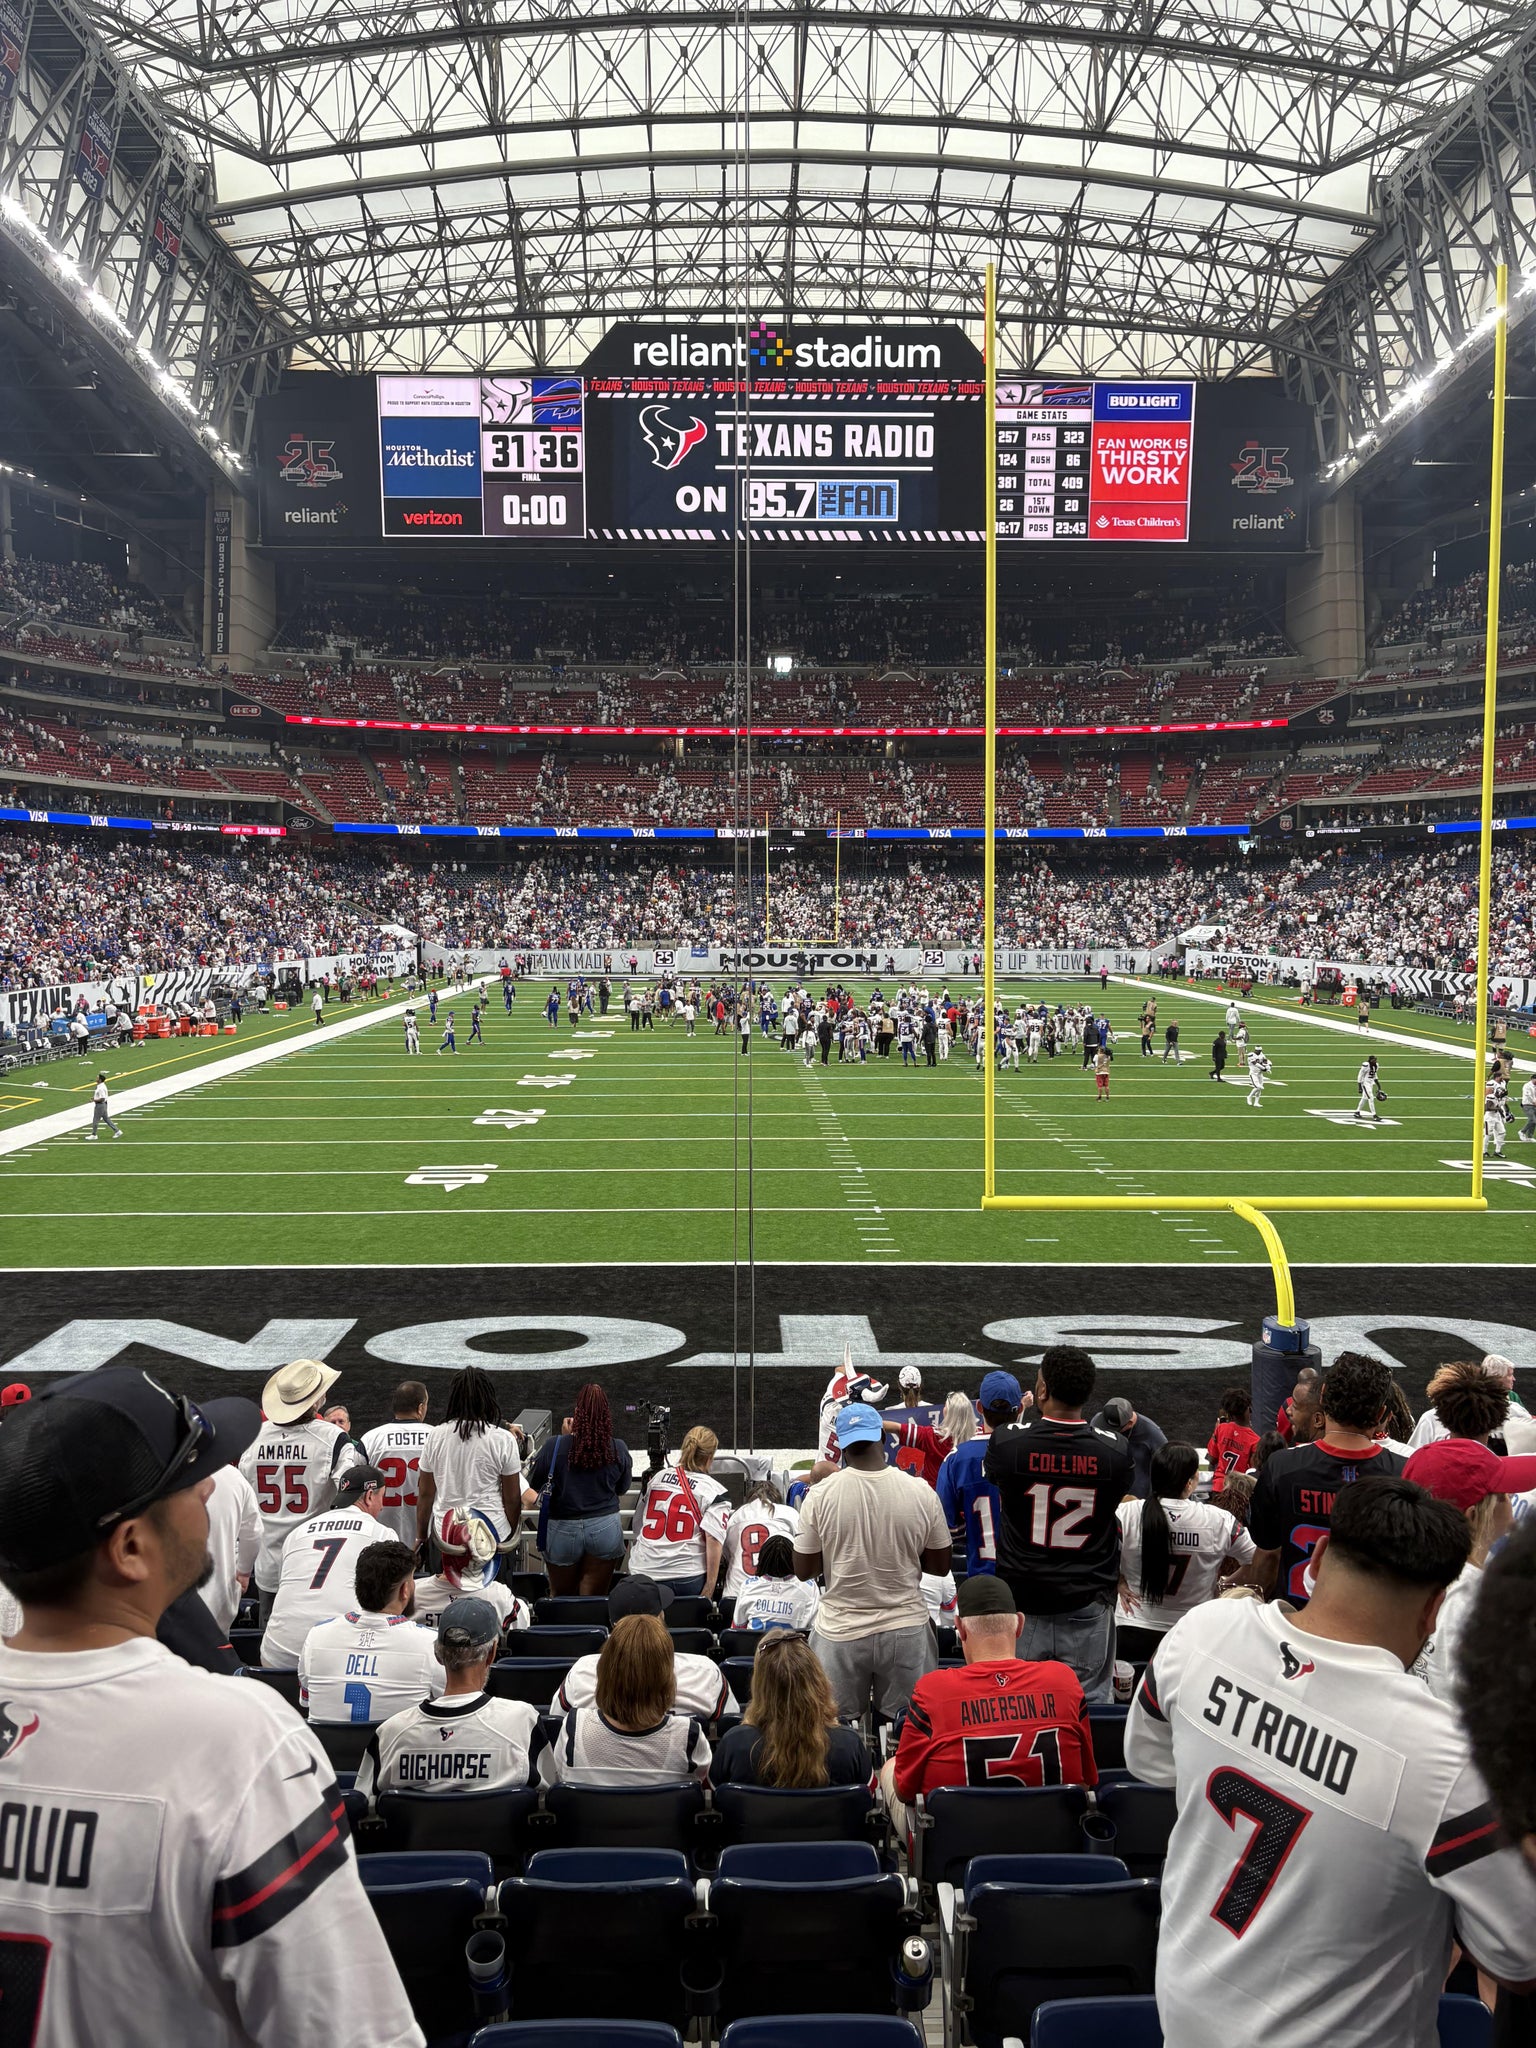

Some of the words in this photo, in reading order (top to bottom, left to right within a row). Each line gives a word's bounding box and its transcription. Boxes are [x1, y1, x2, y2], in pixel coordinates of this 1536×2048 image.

[81, 167, 98, 193] 2023
[155, 249, 170, 272] 2024
[633, 334, 747, 366] reliant
[795, 336, 941, 368] stadium
[590, 381, 623, 391] TEXANS
[631, 381, 670, 392] HOUSTON
[672, 381, 705, 392] TEXANS
[754, 382, 787, 392] TEXANS
[795, 382, 834, 393] HOUSTON
[836, 383, 869, 393] TEXANS
[877, 383, 915, 393] HOUSTON
[917, 383, 950, 393] TEXANS
[1110, 396, 1138, 407] BUD
[1138, 396, 1179, 407] LIGHT
[1017, 411, 1039, 419] GAME
[1042, 411, 1068, 420] STATS
[715, 423, 832, 457] TEXANS
[844, 424, 934, 458] RADIO
[998, 431, 1019, 444] 257
[1031, 433, 1051, 441] PASS
[1063, 431, 1085, 444] 323
[1098, 439, 1126, 449] FAN
[1129, 439, 1172, 449] WORK
[1175, 439, 1188, 449] IS
[387, 448, 475, 467] Methodist
[492, 435, 525, 467] 31
[539, 435, 578, 468] 36
[1097, 450, 1187, 465] THIRSTY
[285, 440, 337, 481] 25
[999, 454, 1018, 466] 124
[1030, 456, 1051, 464] RUSH
[1066, 454, 1081, 466] 86
[1239, 447, 1289, 488] 25
[522, 473, 541, 482] FINAL
[998, 476, 1017, 489] 381
[1028, 479, 1051, 487] TOTAL
[1062, 477, 1083, 489] 409
[1101, 467, 1180, 484] WORK
[675, 486, 727, 513] ON
[748, 482, 815, 518] 95.7
[822, 484, 837, 515] THE
[838, 485, 893, 516] FAN
[1000, 499, 1014, 512] 26
[1028, 505, 1050, 513] DOWN
[1065, 499, 1079, 512] 20
[1033, 497, 1046, 505] 1ST
[285, 508, 338, 523] reliant
[403, 510, 463, 525] verizon
[503, 495, 566, 525] 0:00
[1029, 523, 1048, 532] POSS
[1056, 522, 1086, 534] 23:43
[1112, 518, 1136, 526] Texas
[1137, 517, 1181, 527] Children's
[1232, 514, 1285, 529] reliant
[1319, 710, 1334, 721] 25
[28, 810, 49, 823] VISA
[89, 815, 109, 827] VISA
[290, 819, 309, 828] Ford
[396, 825, 421, 835] VISA
[476, 826, 501, 836] VISA
[554, 827, 579, 837] VISA
[632, 828, 656, 838] VISA
[927, 828, 952, 838] VISA
[1005, 828, 1029, 838] VISA
[1082, 827, 1107, 838] VISA
[1162, 826, 1188, 836] VISA
[657, 953, 673, 964] 25
[719, 953, 878, 968] HOUSTON
[925, 952, 942, 964] 25
[1211, 954, 1269, 968] HOUSTON
[8, 986, 72, 1024] TEXANS
[387, 1432, 429, 1446] FOSTE
[257, 1444, 308, 1460] AMARAL
[824, 1432, 842, 1464] 5
[1029, 1452, 1098, 1475] COLLINS
[1222, 1451, 1240, 1474] 7
[256, 1465, 309, 1514] 55
[642, 1490, 695, 1542] 56
[1025, 1482, 1097, 1549] 12
[307, 1520, 363, 1533] STROUD
[1170, 1531, 1199, 1547] ROUD
[741, 1523, 770, 1576] 8
[309, 1537, 347, 1590] 7
[756, 1598, 794, 1616] COLLINS
[345, 1654, 379, 1677] DELL
[961, 1695, 1038, 1727] ANDERSON
[1040, 1693, 1057, 1719] JR
[1203, 1674, 1358, 1796] STROUD
[962, 1727, 1063, 1787] 51
[400, 1753, 492, 1781] BIGHORSE
[1205, 1765, 1314, 1940] 7
